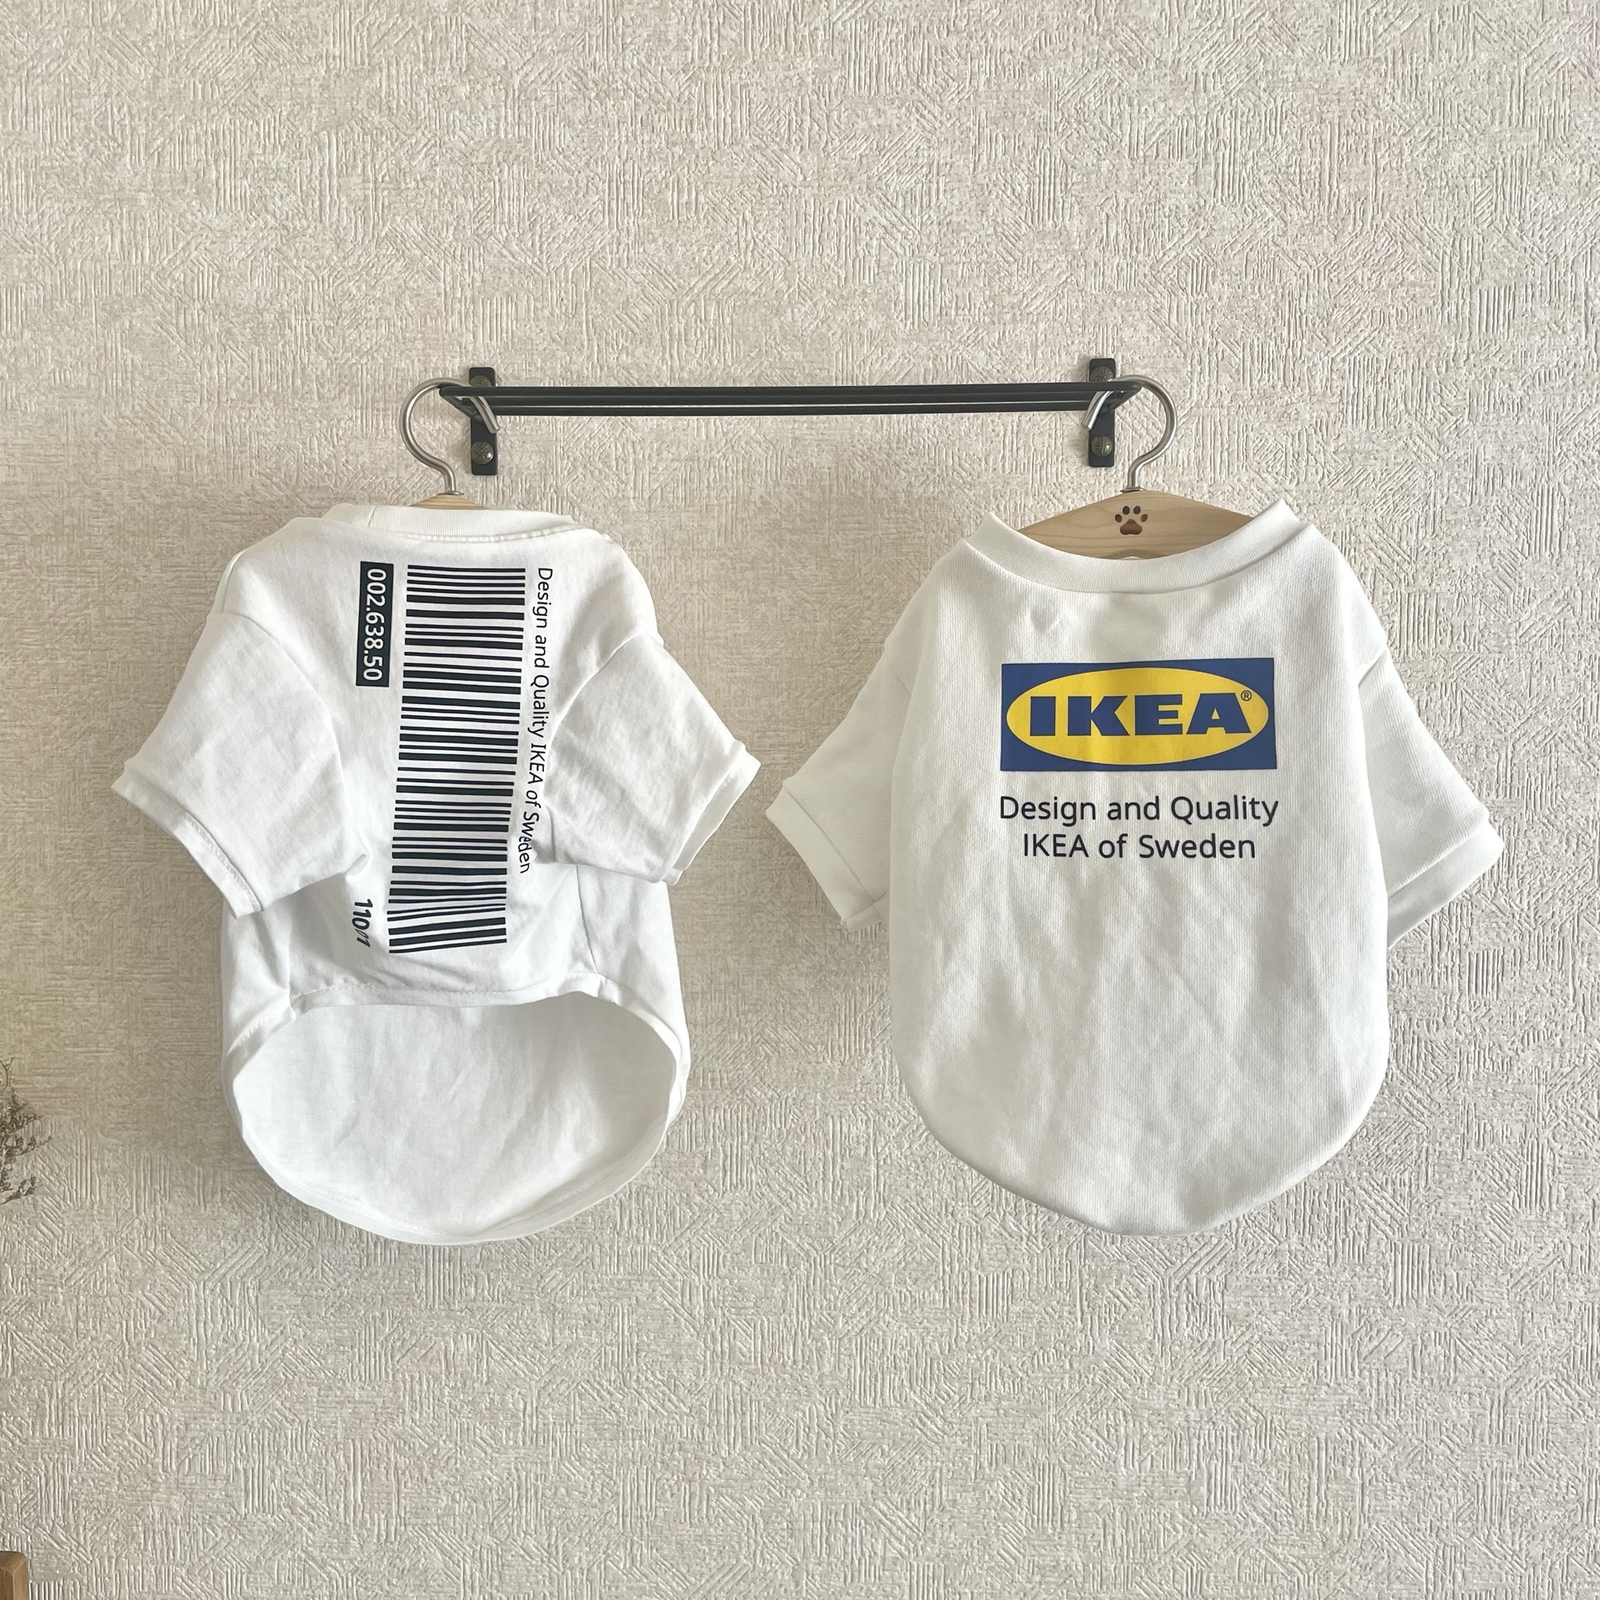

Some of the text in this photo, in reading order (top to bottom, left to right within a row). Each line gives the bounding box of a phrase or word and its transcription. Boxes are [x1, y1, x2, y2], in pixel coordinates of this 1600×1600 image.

[363, 568, 387, 681] 002.638.50
[517, 567, 553, 874] Design and Quality IKEA of Sweden
[1000, 794, 1279, 827] Design and Quality
[1023, 832, 1256, 858] IKEA of Sweden
